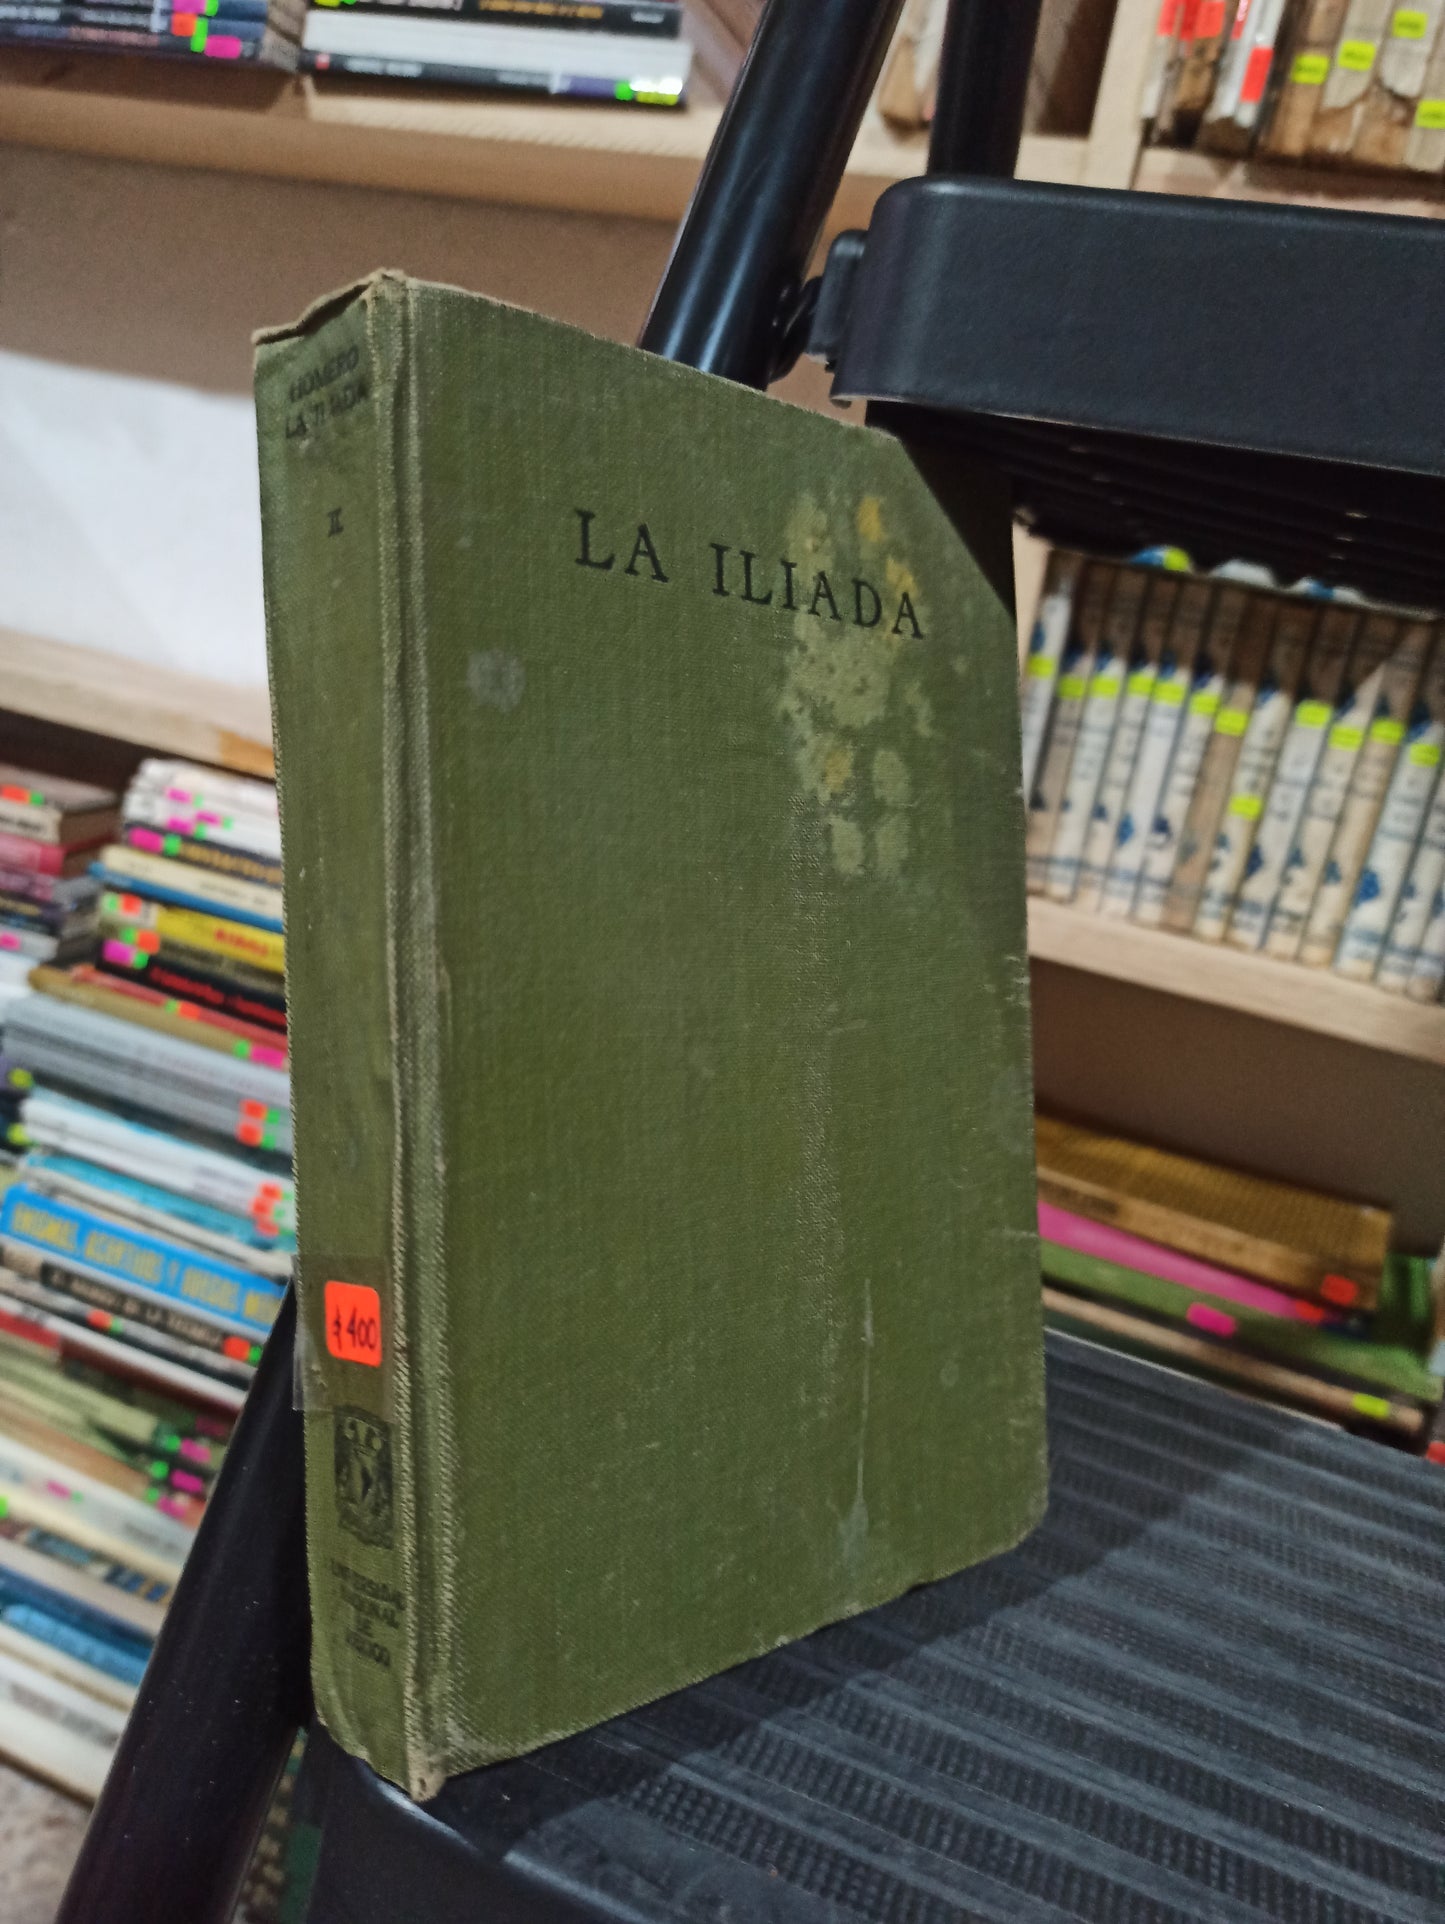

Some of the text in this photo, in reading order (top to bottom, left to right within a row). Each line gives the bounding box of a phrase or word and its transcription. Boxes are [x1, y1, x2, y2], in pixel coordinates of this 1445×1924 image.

[574, 508, 924, 640] LA ILIADA
[333, 1303, 379, 1352] $400
